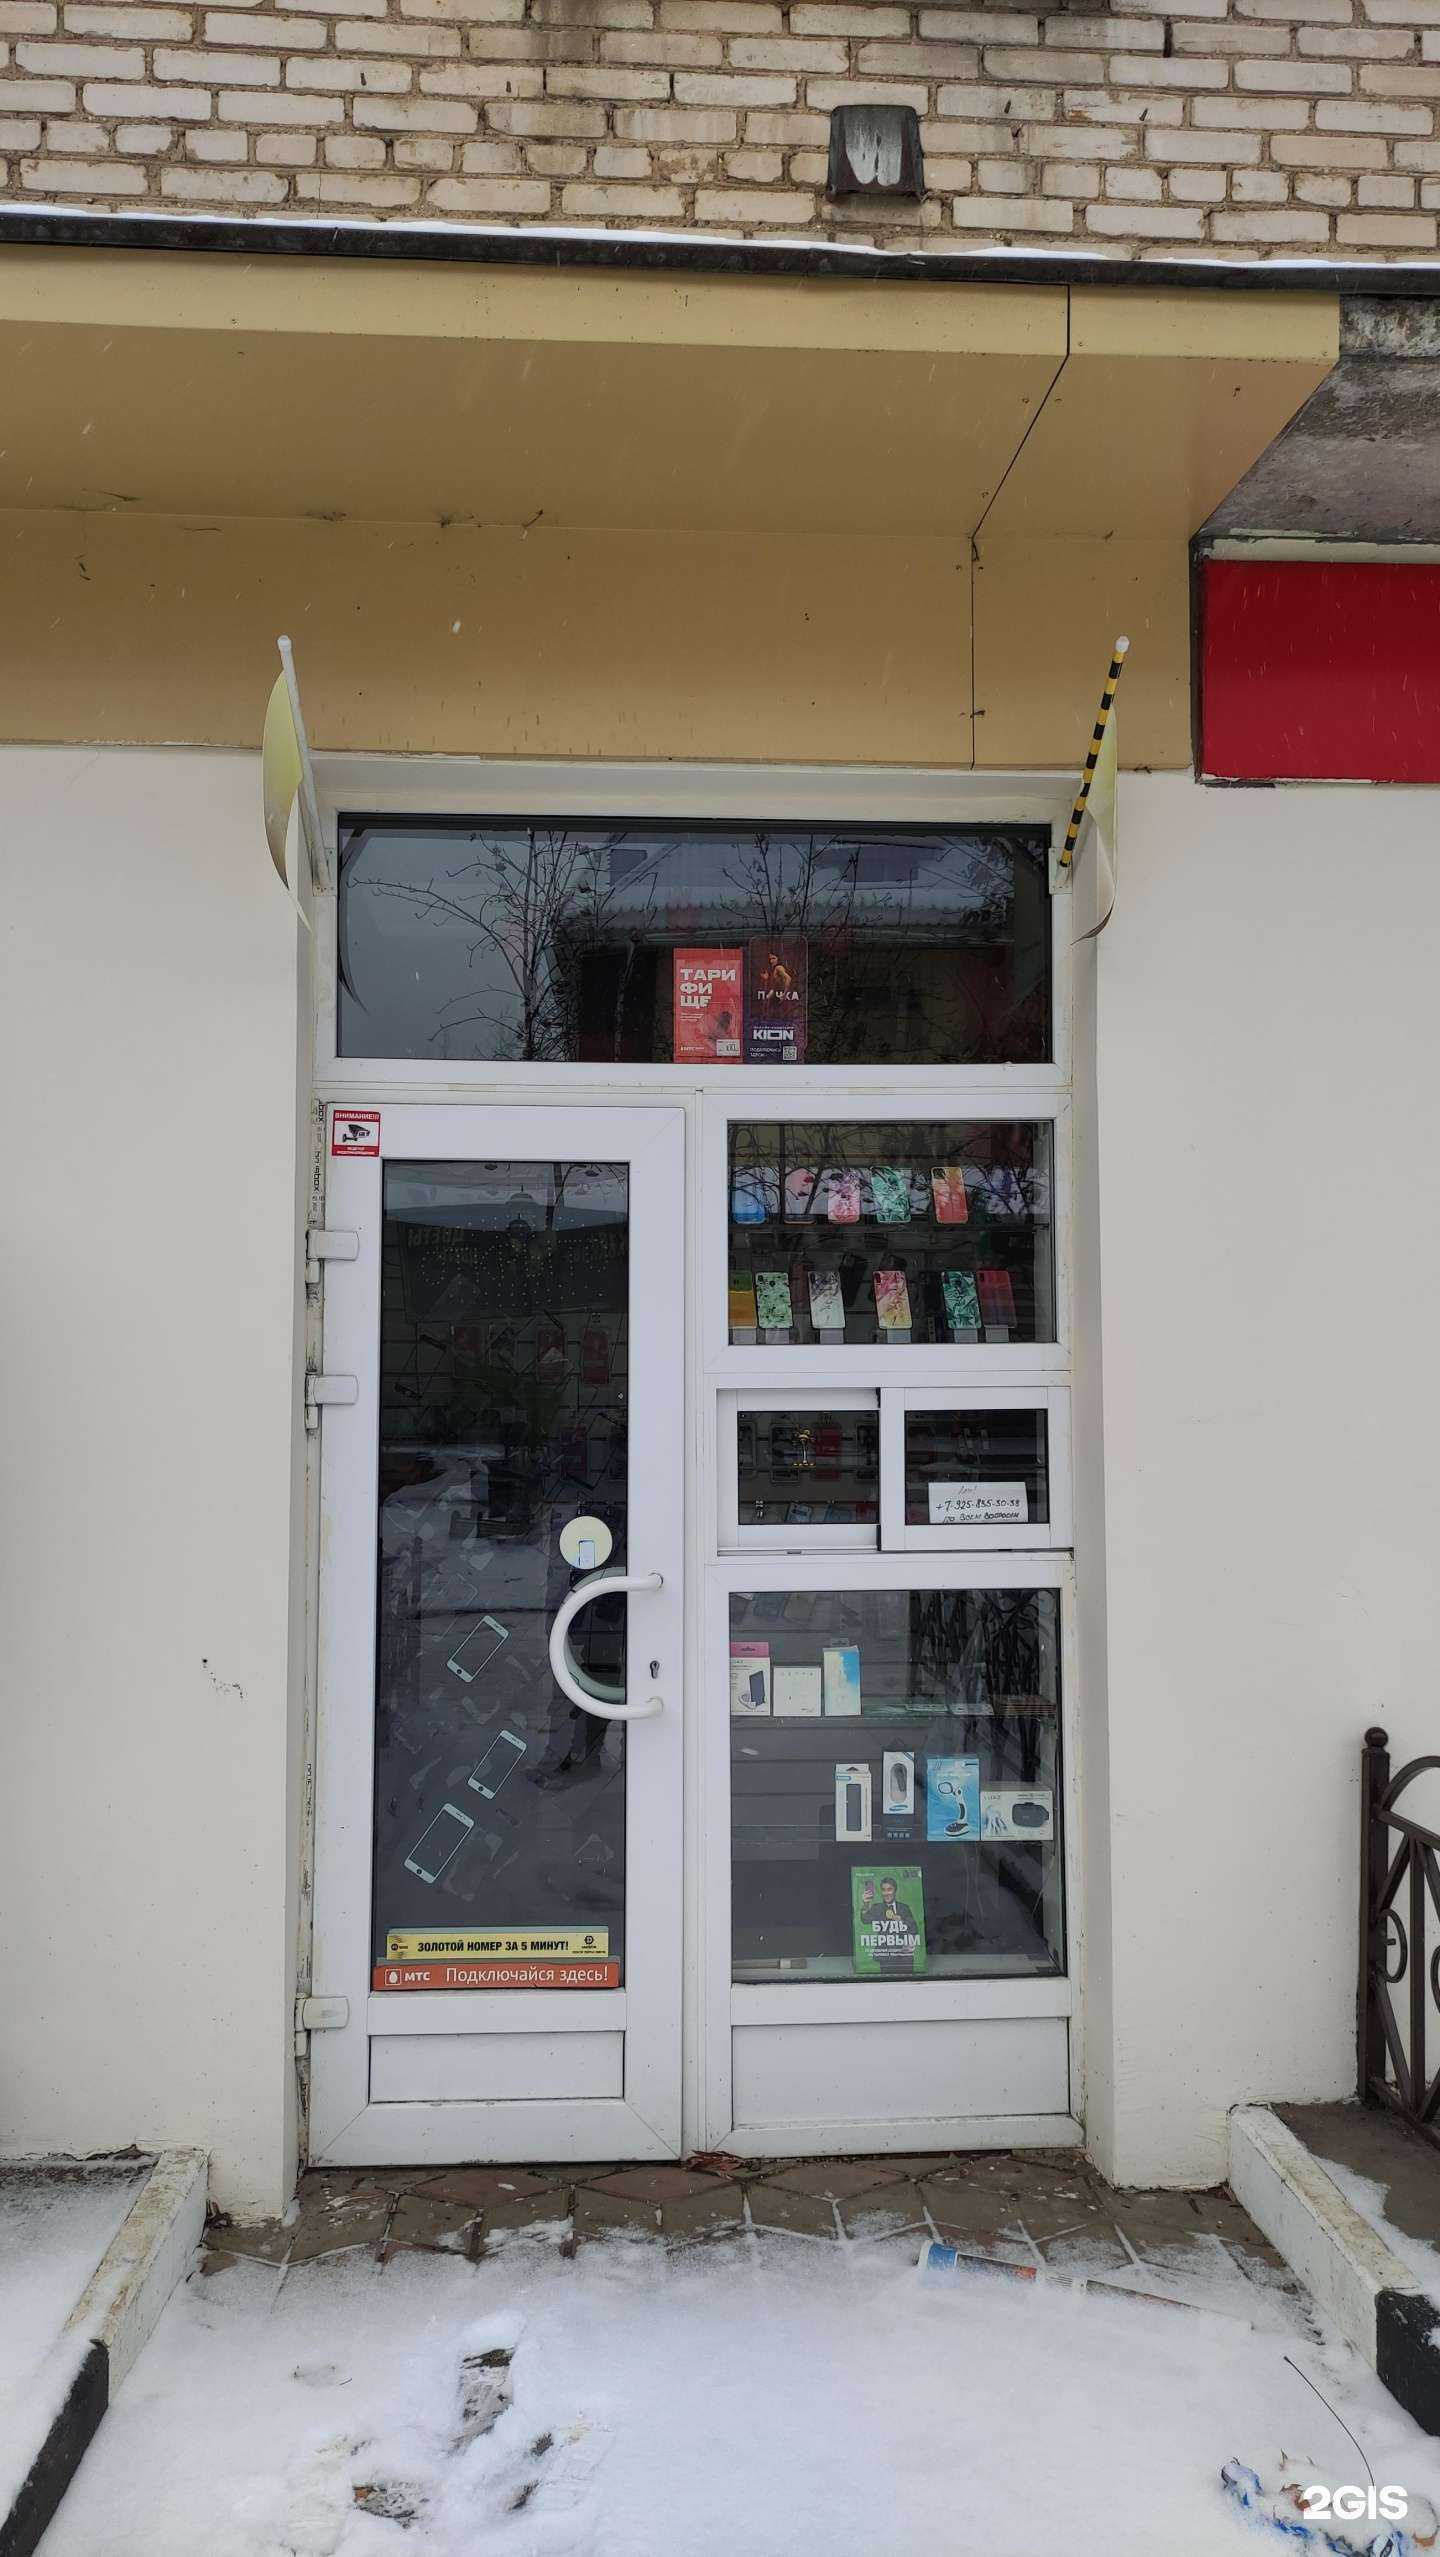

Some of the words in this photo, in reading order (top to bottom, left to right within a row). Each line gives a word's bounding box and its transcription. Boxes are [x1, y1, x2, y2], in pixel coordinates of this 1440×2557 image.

[680, 969, 736, 981] ТАРИ
[680, 982, 712, 994] ФИ
[757, 990, 799, 1001] ПЧКА
[680, 995, 712, 1009] ЩЕ
[753, 1029, 794, 1041] KION
[872, 1920, 908, 1933] БУДЬ
[418, 1940, 464, 1952] ЗОЛОТОЙ
[467, 1941, 502, 1951] НОМЕР
[505, 1941, 518, 1951] ЗА
[521, 1941, 528, 1951] 5
[530, 1941, 569, 1951] МИНУТ!
[860, 1934, 920, 1946] ПЕРВЫМ
[404, 1971, 431, 1982] МТС
[446, 1966, 554, 1984] Подключайся
[560, 1966, 608, 1983] здесь!
